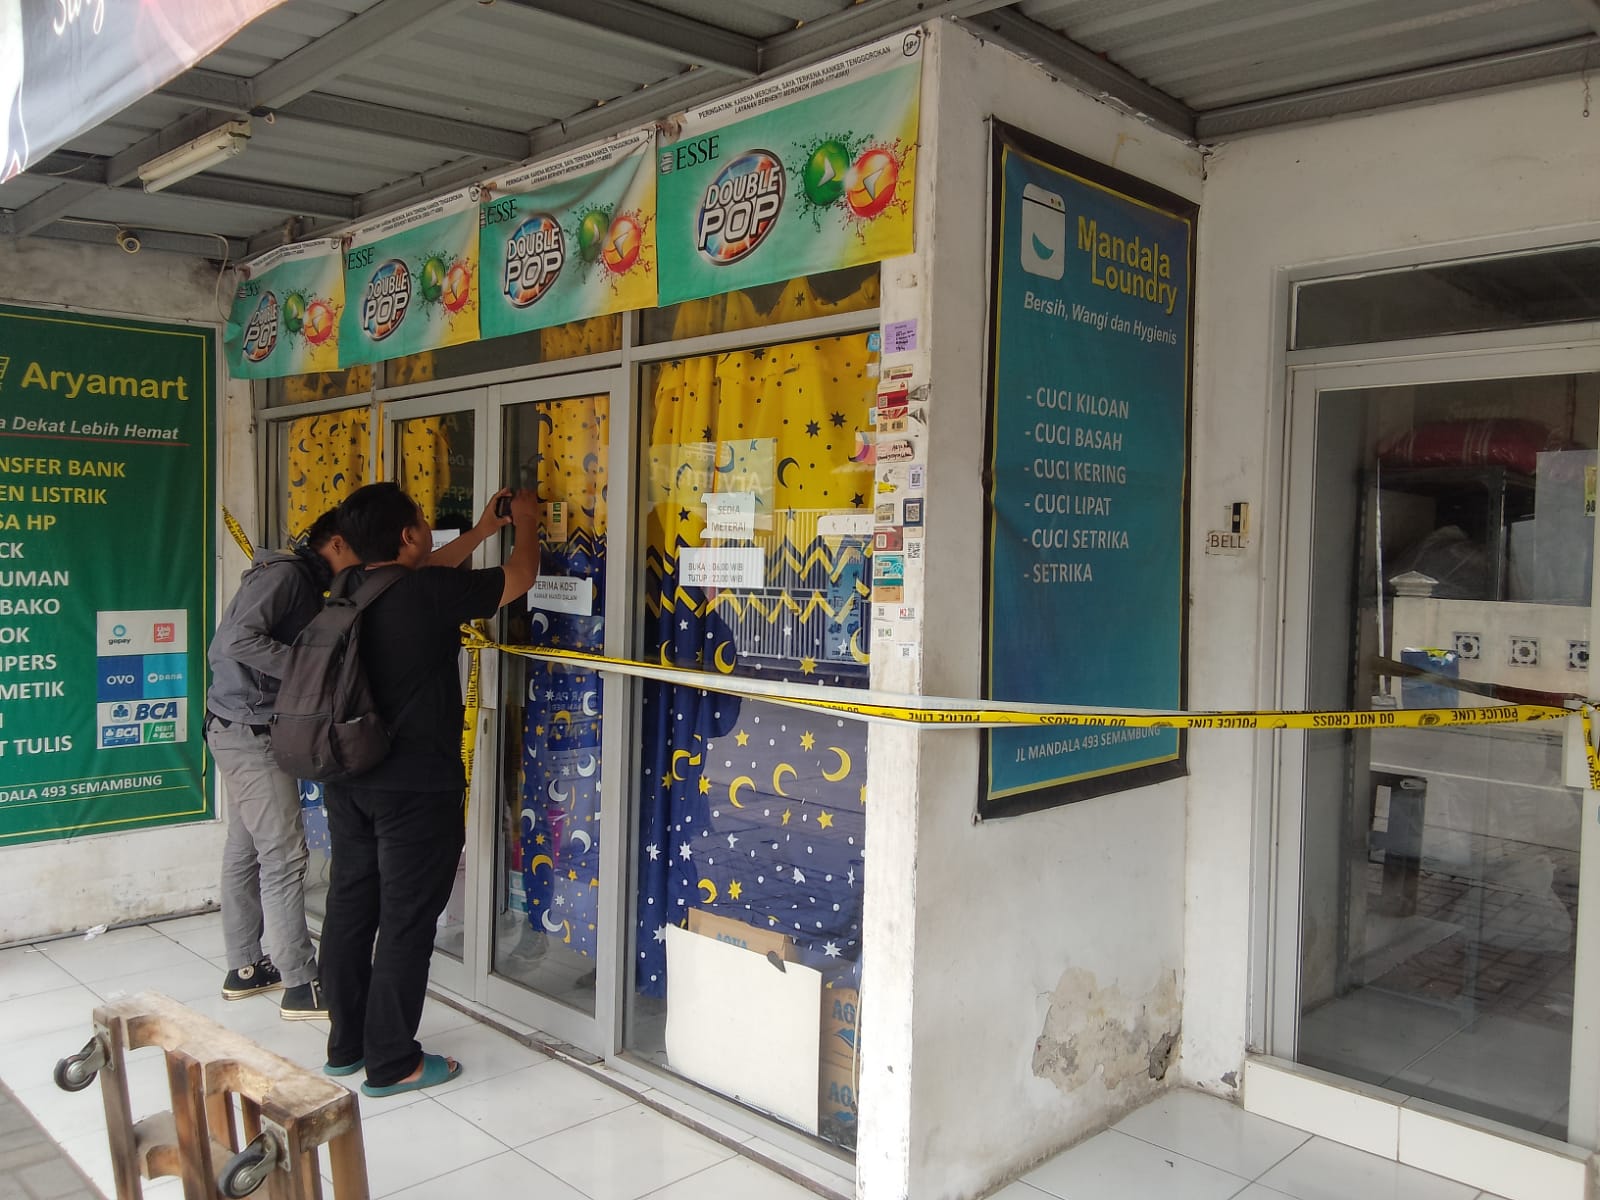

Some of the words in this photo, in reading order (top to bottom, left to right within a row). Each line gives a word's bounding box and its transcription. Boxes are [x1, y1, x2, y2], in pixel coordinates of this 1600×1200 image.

[676, 135, 720, 171] ESSE
[704, 165, 780, 210] DOUBLE
[487, 198, 517, 226] ESSE
[697, 194, 779, 251] POP
[506, 228, 560, 260] DOUBLE
[1077, 215, 1171, 279] Mandala
[347, 246, 376, 271] ESSE
[504, 250, 562, 295] POP
[1090, 252, 1179, 314] Loundry
[367, 272, 408, 301] DOUBLE
[363, 292, 409, 331] POP
[1023, 291, 1068, 320] Bersih,
[1072, 303, 1108, 331] Wangi
[1110, 313, 1131, 333] dan
[1133, 320, 1177, 345] Hygienis
[243, 325, 278, 350] POP
[20, 361, 190, 401] Aryamart
[1036, 387, 1072, 412] CUCI
[1076, 395, 1130, 419] KILOAN
[12, 415, 66, 434] Dekat
[70, 418, 119, 437] Lebih
[124, 423, 179, 440] Hemat
[1034, 423, 1071, 446] CUCI
[1075, 428, 1123, 452] BASAH
[68, 459, 127, 478] BANK
[1033, 458, 1070, 481] CUCI
[1074, 463, 1127, 485] KERING
[32, 485, 108, 505] LISTRIK
[1034, 493, 1070, 515] CUCI
[1074, 496, 1113, 516] LIPAT
[27, 514, 57, 531] HP
[1031, 528, 1069, 549] CUCI
[1072, 529, 1130, 549] SETRIKA
[1210, 534, 1246, 549] BELL
[1032, 563, 1093, 583] SETRIKA
[536, 580, 559, 591] TERIMA
[559, 581, 578, 592] KOST
[0, 626, 30, 644] OK
[106, 674, 135, 685] OVO
[134, 701, 178, 721] BCA
[1217, 717, 1257, 728] POLICE
[1313, 714, 1350, 727] CROSS
[1354, 713, 1375, 725] NOT
[1379, 712, 1395, 724] DO
[1451, 709, 1477, 722] LINE
[1480, 707, 1518, 720] POLICE
[115, 726, 139, 738] BCA
[1187, 719, 1213, 728] LINE
[13, 735, 73, 755] TULIS
[1016, 748, 1026, 762] JL
[1028, 738, 1081, 760] MANDALA
[1082, 734, 1099, 749] 493
[1100, 727, 1161, 746] SEMAMBUNG
[41, 784, 67, 798] 493
[70, 775, 162, 795] SEMAMBUNG
